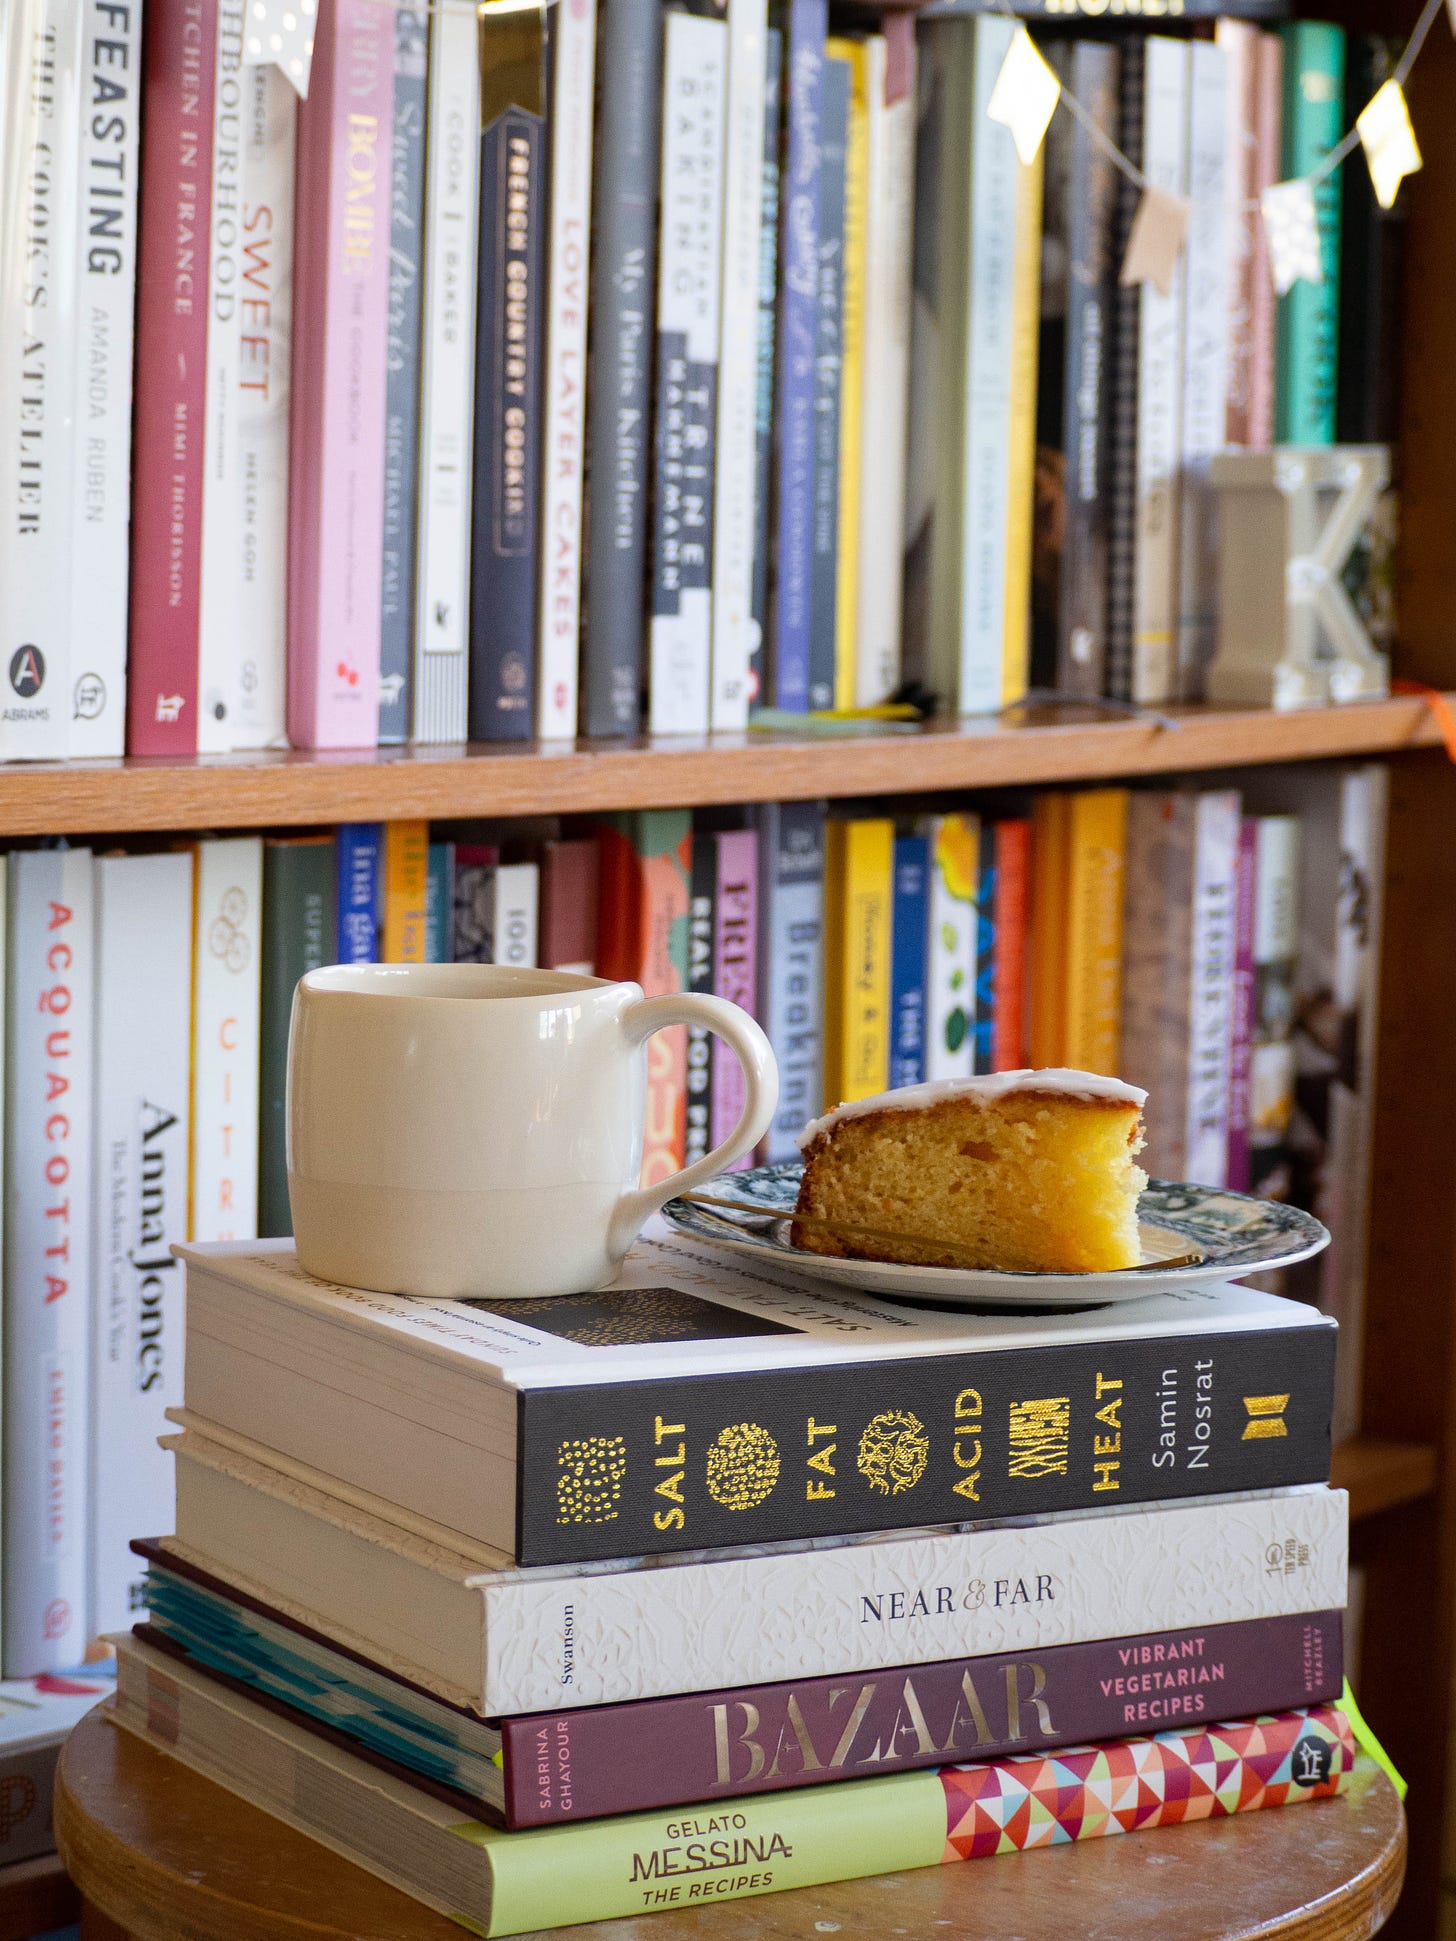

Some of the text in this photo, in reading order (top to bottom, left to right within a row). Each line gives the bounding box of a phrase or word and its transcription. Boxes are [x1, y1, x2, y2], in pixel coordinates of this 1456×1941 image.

[32, 25, 57, 119] THE
[87, 3, 130, 276] FEASTING
[179, 131, 199, 167] IN
[506, 137, 530, 251] FRENCH
[174, 183, 197, 316] FRANCE
[240, 205, 273, 400] SWEET
[559, 219, 580, 328] LOVE
[505, 260, 529, 395] COUNTRY
[19, 332, 46, 535] ATELIER
[86, 307, 110, 524] AMANDA RUBEN
[173, 403, 188, 461] MIMI
[558, 350, 580, 478] LAYER
[680, 388, 711, 565] TRINE
[554, 503, 573, 637] CAKES
[690, 896, 712, 984] REAL
[776, 921, 820, 1134] Breaking
[38, 901, 74, 1304] ACQUACOTTA
[127, 1099, 179, 1393] Anna Jones
[806, 1416, 837, 1501] FAT
[952, 1388, 983, 1501] ACID
[1092, 1372, 1123, 1491] HEAT
[1152, 1368, 1178, 1468] Samin
[1187, 1359, 1213, 1469] Nosrat
[653, 1414, 686, 1531] SALT
[561, 1604, 574, 1684] Swanson
[860, 1573, 1056, 1624] NEAR & FAR
[1118, 1639, 1205, 1667] VIBRANT
[706, 1661, 1061, 1788] BAZAAR
[1100, 1664, 1225, 1698] VEGETARIAN
[1123, 1694, 1205, 1722] RECIPES
[540, 1727, 551, 1809] SABRINA
[561, 1721, 572, 1810] GHAYOUR
[629, 1831, 793, 1882] MESSINA
[666, 1813, 747, 1839] GELATO
[642, 1871, 773, 1905] THE RECIPES
